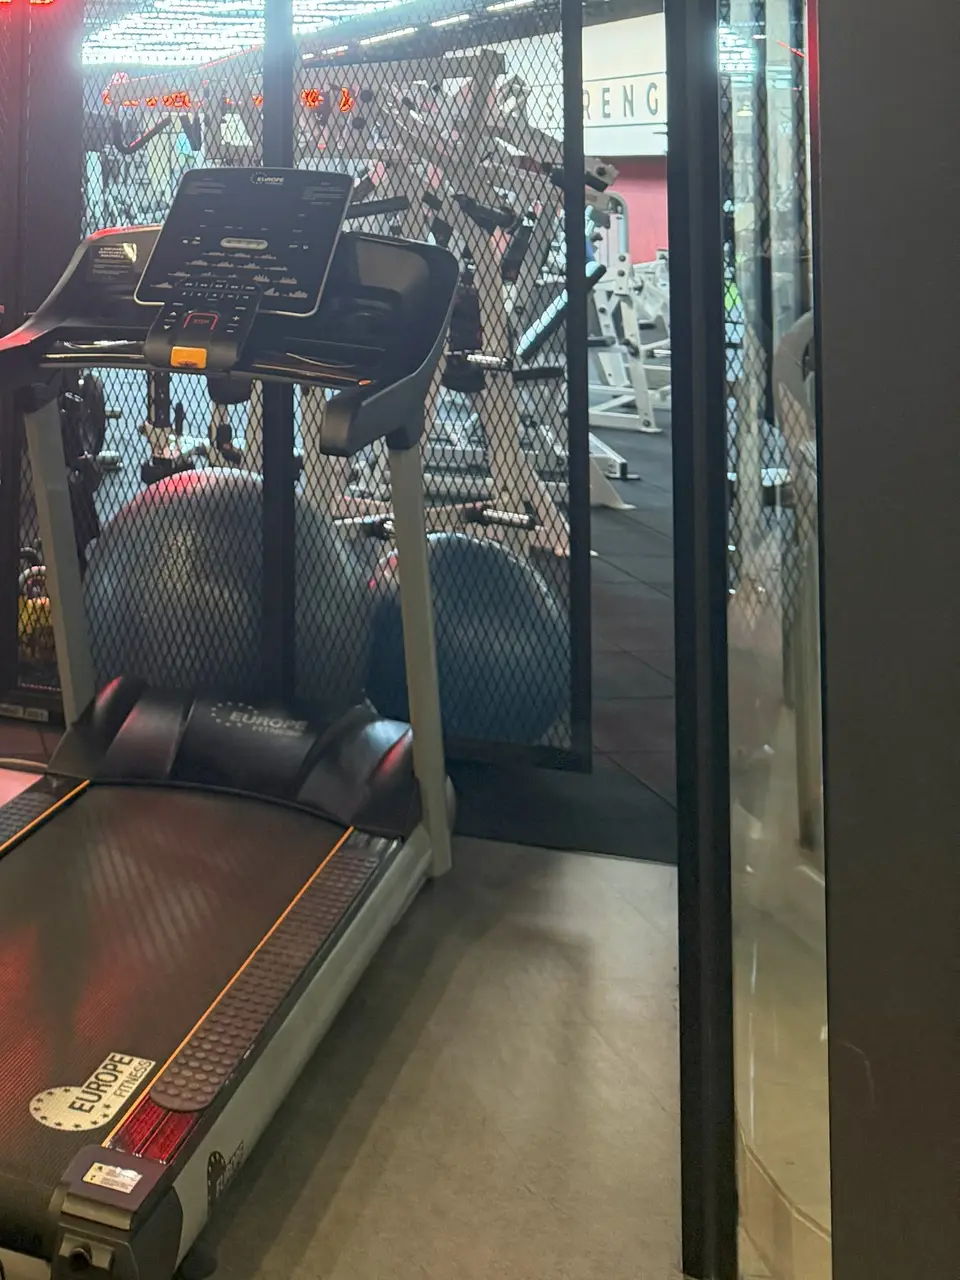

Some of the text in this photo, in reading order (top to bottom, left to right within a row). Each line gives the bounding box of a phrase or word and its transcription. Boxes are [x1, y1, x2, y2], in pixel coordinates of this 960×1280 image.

[229, 711, 308, 730] EUROPE
[68, 1054, 135, 1113] EUROPE
[114, 1060, 152, 1098] FITNESS
